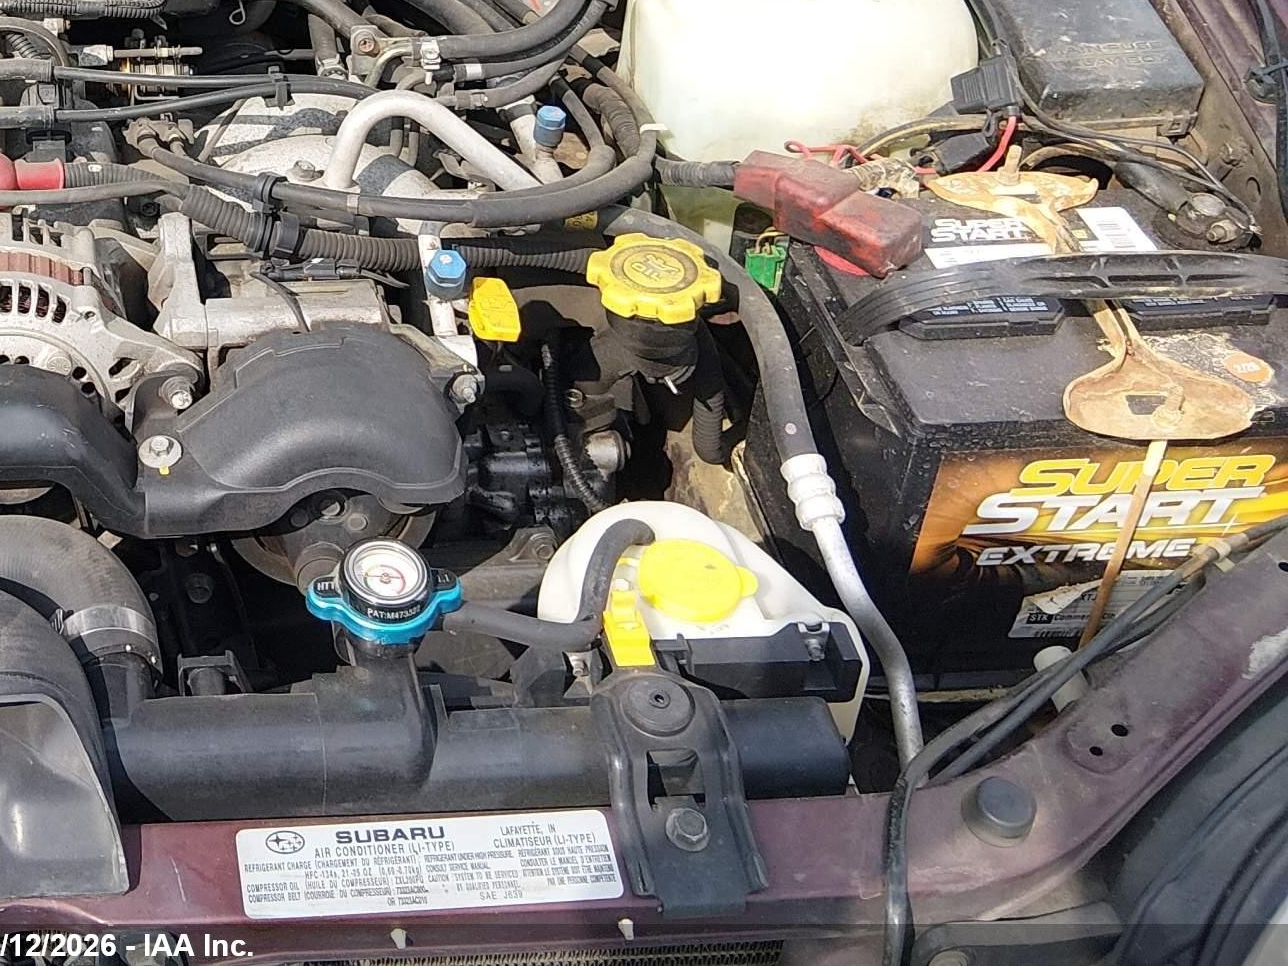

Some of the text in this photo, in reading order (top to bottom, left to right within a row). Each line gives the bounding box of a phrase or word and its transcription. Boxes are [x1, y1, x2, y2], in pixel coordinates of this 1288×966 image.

[631, 262, 663, 282] OIL
[1011, 454, 1276, 496] SUPER
[962, 486, 1266, 535] START
[335, 825, 445, 845] SUBARU
[500, 823, 556, 836] LAFAYETTE, IN
[493, 832, 596, 848] CLIMATISEUR (LI-TYPE)
[314, 841, 454, 859] AIR CONDITIONER (LI-TYPE)
[244, 862, 285, 873] REFRIGERANT
[287, 860, 312, 871] CHARGE
[315, 858, 358, 870] (CHARGEMENT
[361, 857, 370, 867] DU
[247, 883, 288, 893] COMPRESSOR
[289, 881, 300, 891] OIL
[329, 879, 338, 889] DU
[248, 893, 286, 904] COMPRESSOR
[288, 891, 301, 902] BELT
[339, 889, 348, 899] DU
[387, 897, 396, 907] OR
[479, 889, 523, 901] SAE J639
